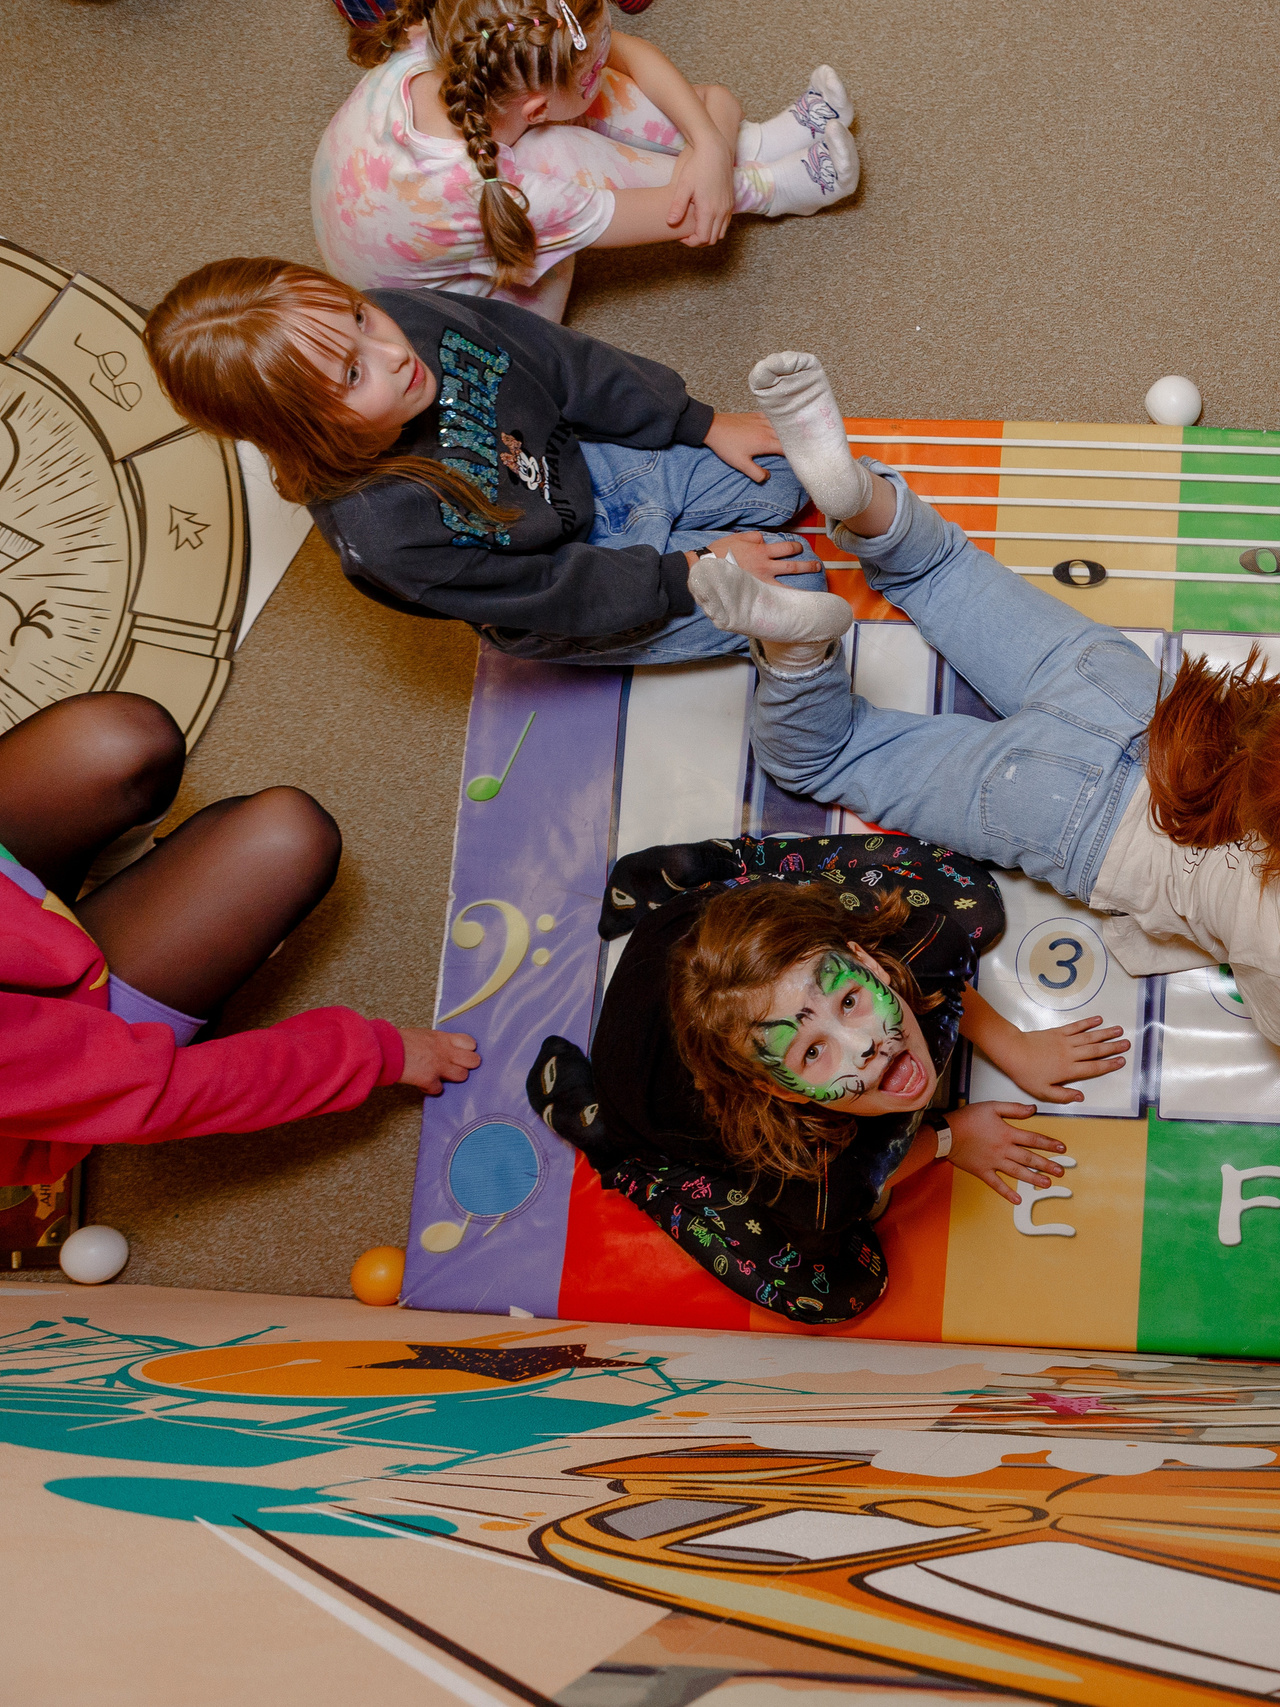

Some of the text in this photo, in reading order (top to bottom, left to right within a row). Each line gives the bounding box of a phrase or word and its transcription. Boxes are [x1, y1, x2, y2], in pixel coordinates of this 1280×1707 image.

[1038, 938, 1083, 988] 3
[1013, 1155, 1077, 1237] E
[775, 1250, 798, 1268] SUMMER
[857, 1243, 872, 1268] FUN
[869, 1251, 882, 1277] FUN
